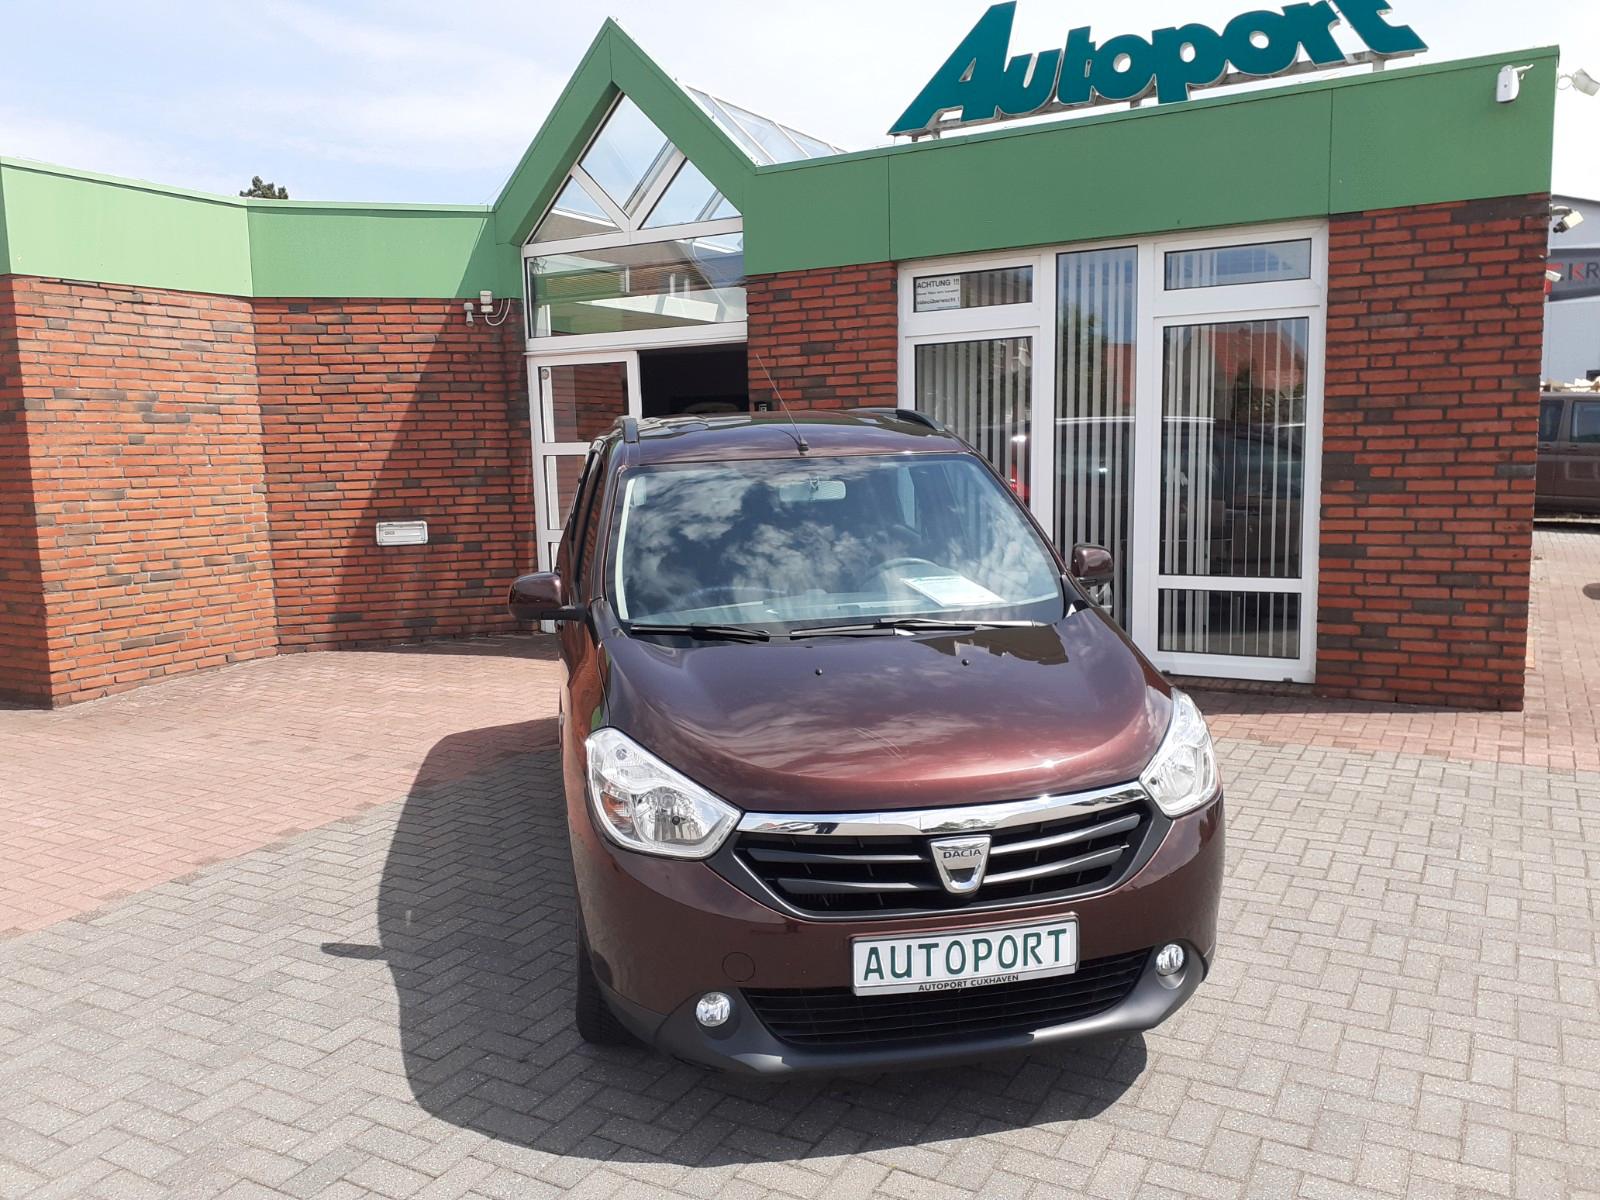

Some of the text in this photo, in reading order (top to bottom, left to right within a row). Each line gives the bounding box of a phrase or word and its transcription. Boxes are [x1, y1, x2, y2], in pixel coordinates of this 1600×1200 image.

[887, 0, 1429, 135] Autoport
[917, 279, 951, 289] ACHTUNG
[943, 848, 982, 859] DACIA
[863, 928, 1067, 981] AUTOPORT
[918, 974, 1019, 992] AUTOPORT CUXHAVEN
